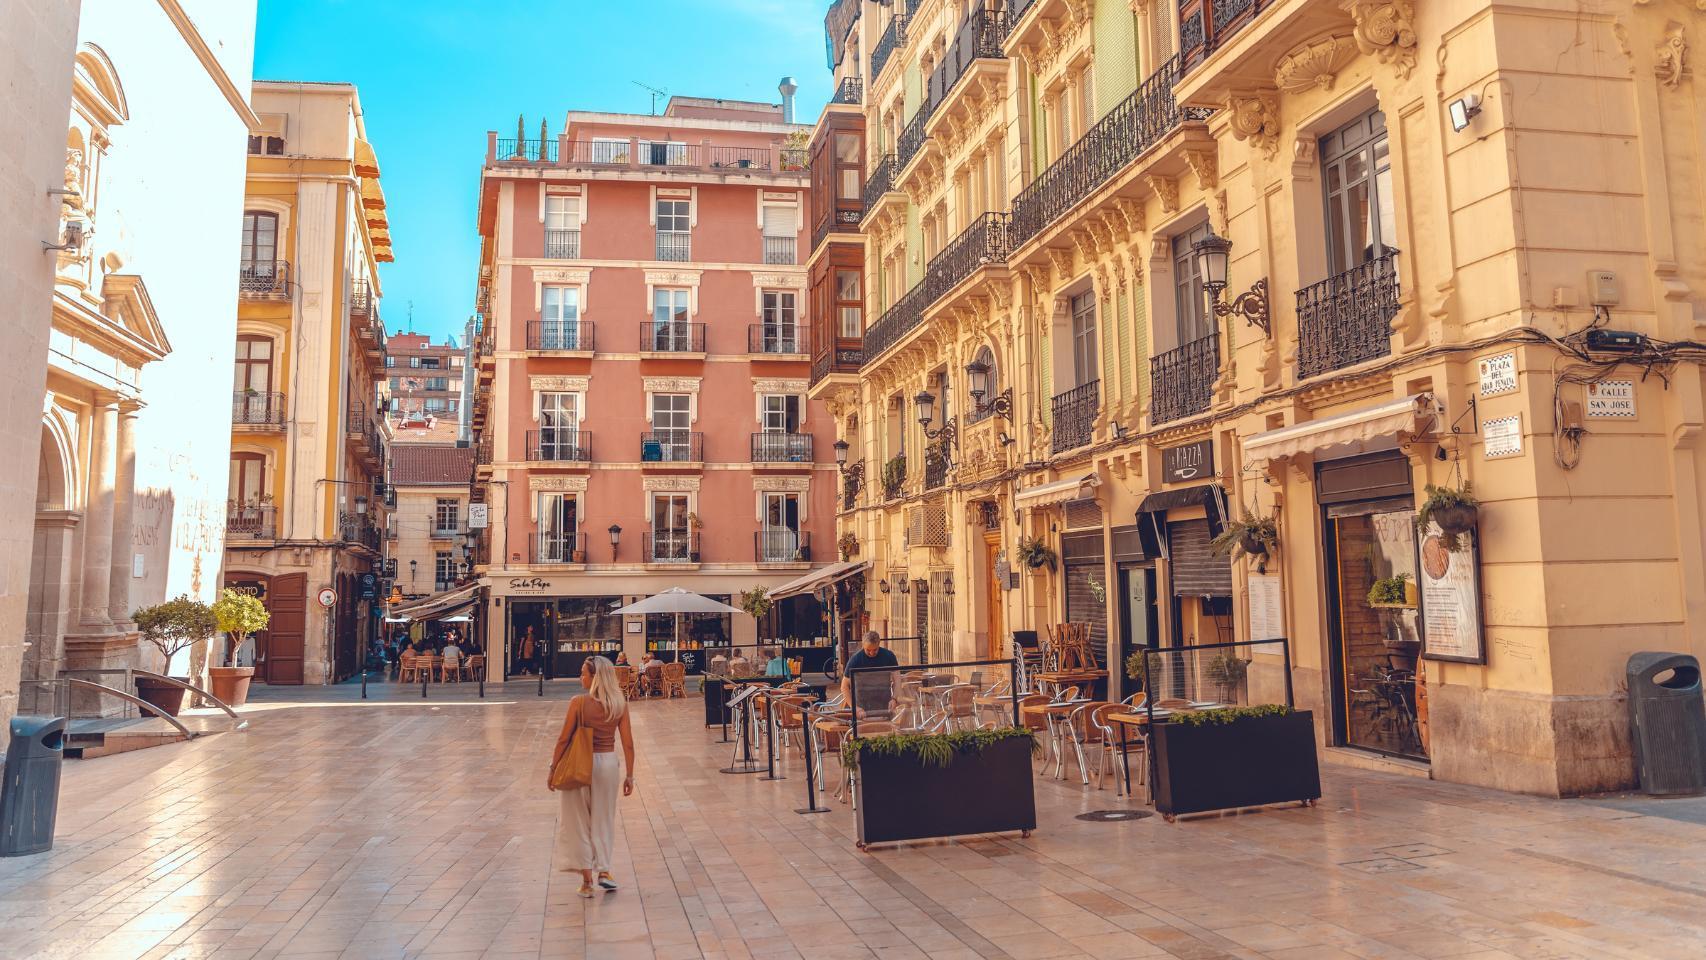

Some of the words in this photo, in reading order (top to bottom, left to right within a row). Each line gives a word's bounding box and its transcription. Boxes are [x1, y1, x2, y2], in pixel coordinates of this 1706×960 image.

[1490, 360, 1510, 371] PLAZA
[1491, 370, 1503, 379] DEL
[1601, 388, 1627, 396] CALLE
[1590, 400, 1606, 408] SAN
[1176, 443, 1202, 469] PIAZZA
